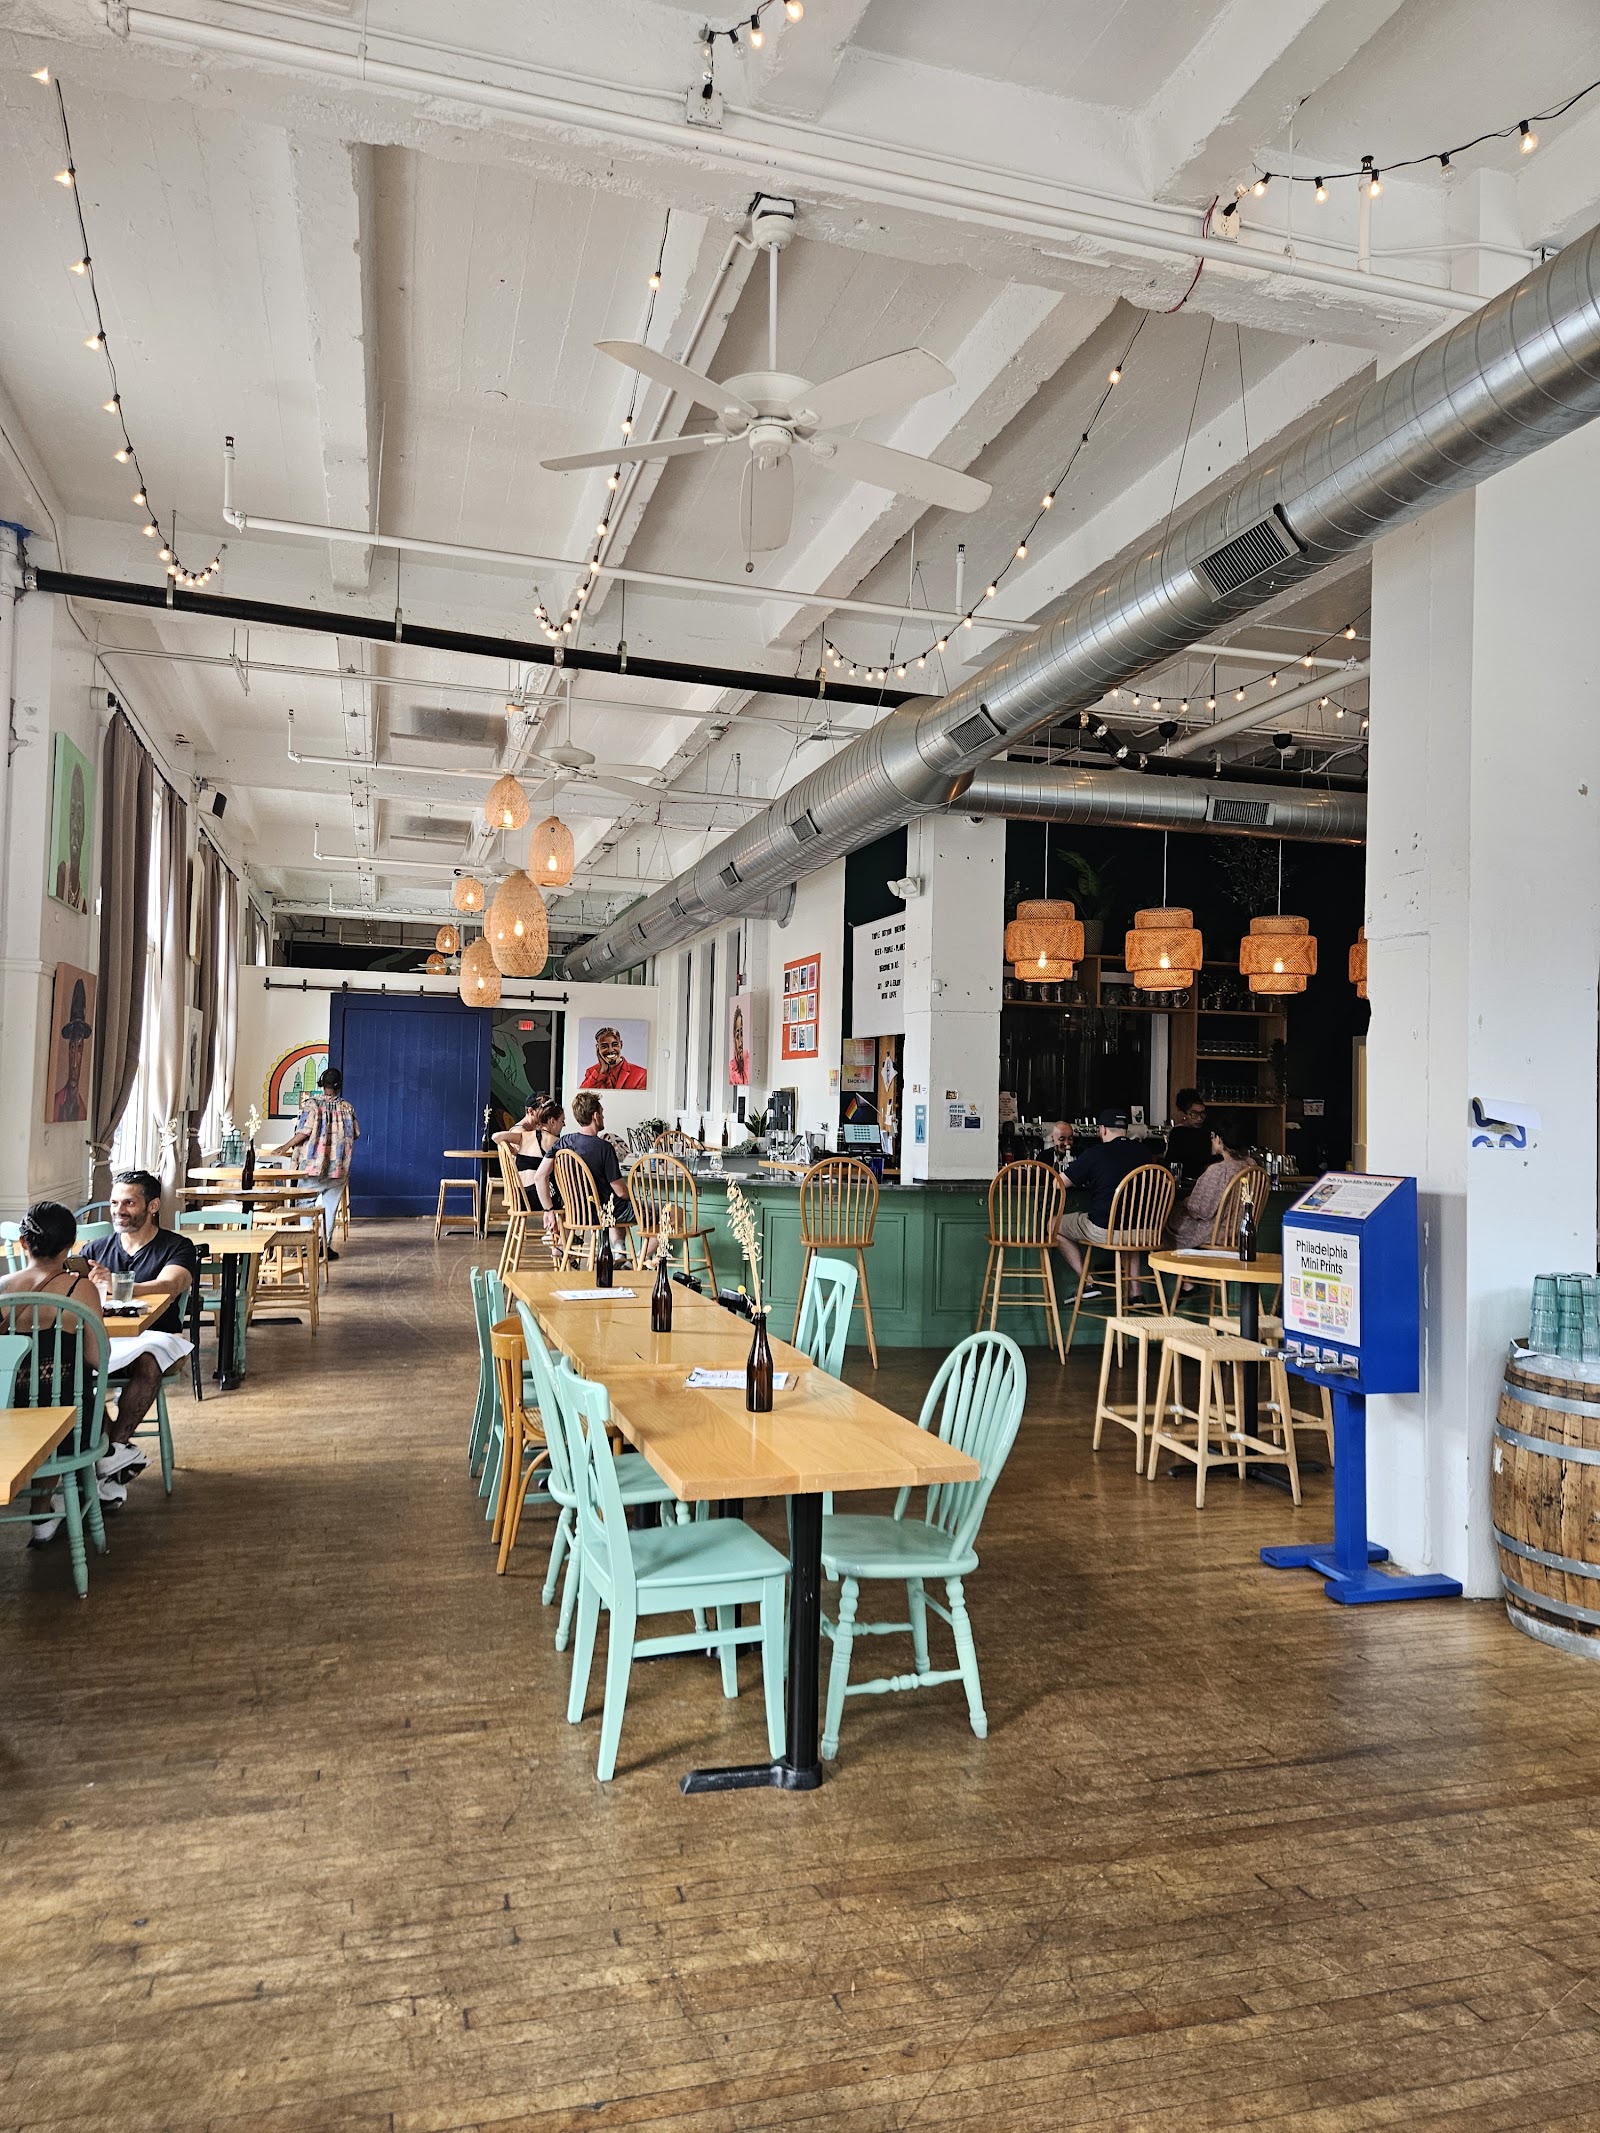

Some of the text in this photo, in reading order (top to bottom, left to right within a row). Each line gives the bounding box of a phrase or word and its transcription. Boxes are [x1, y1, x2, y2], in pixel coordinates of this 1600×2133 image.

[1296, 1240, 1348, 1259] Philadelphia
[1301, 1256, 1343, 1275] Mini Prints
